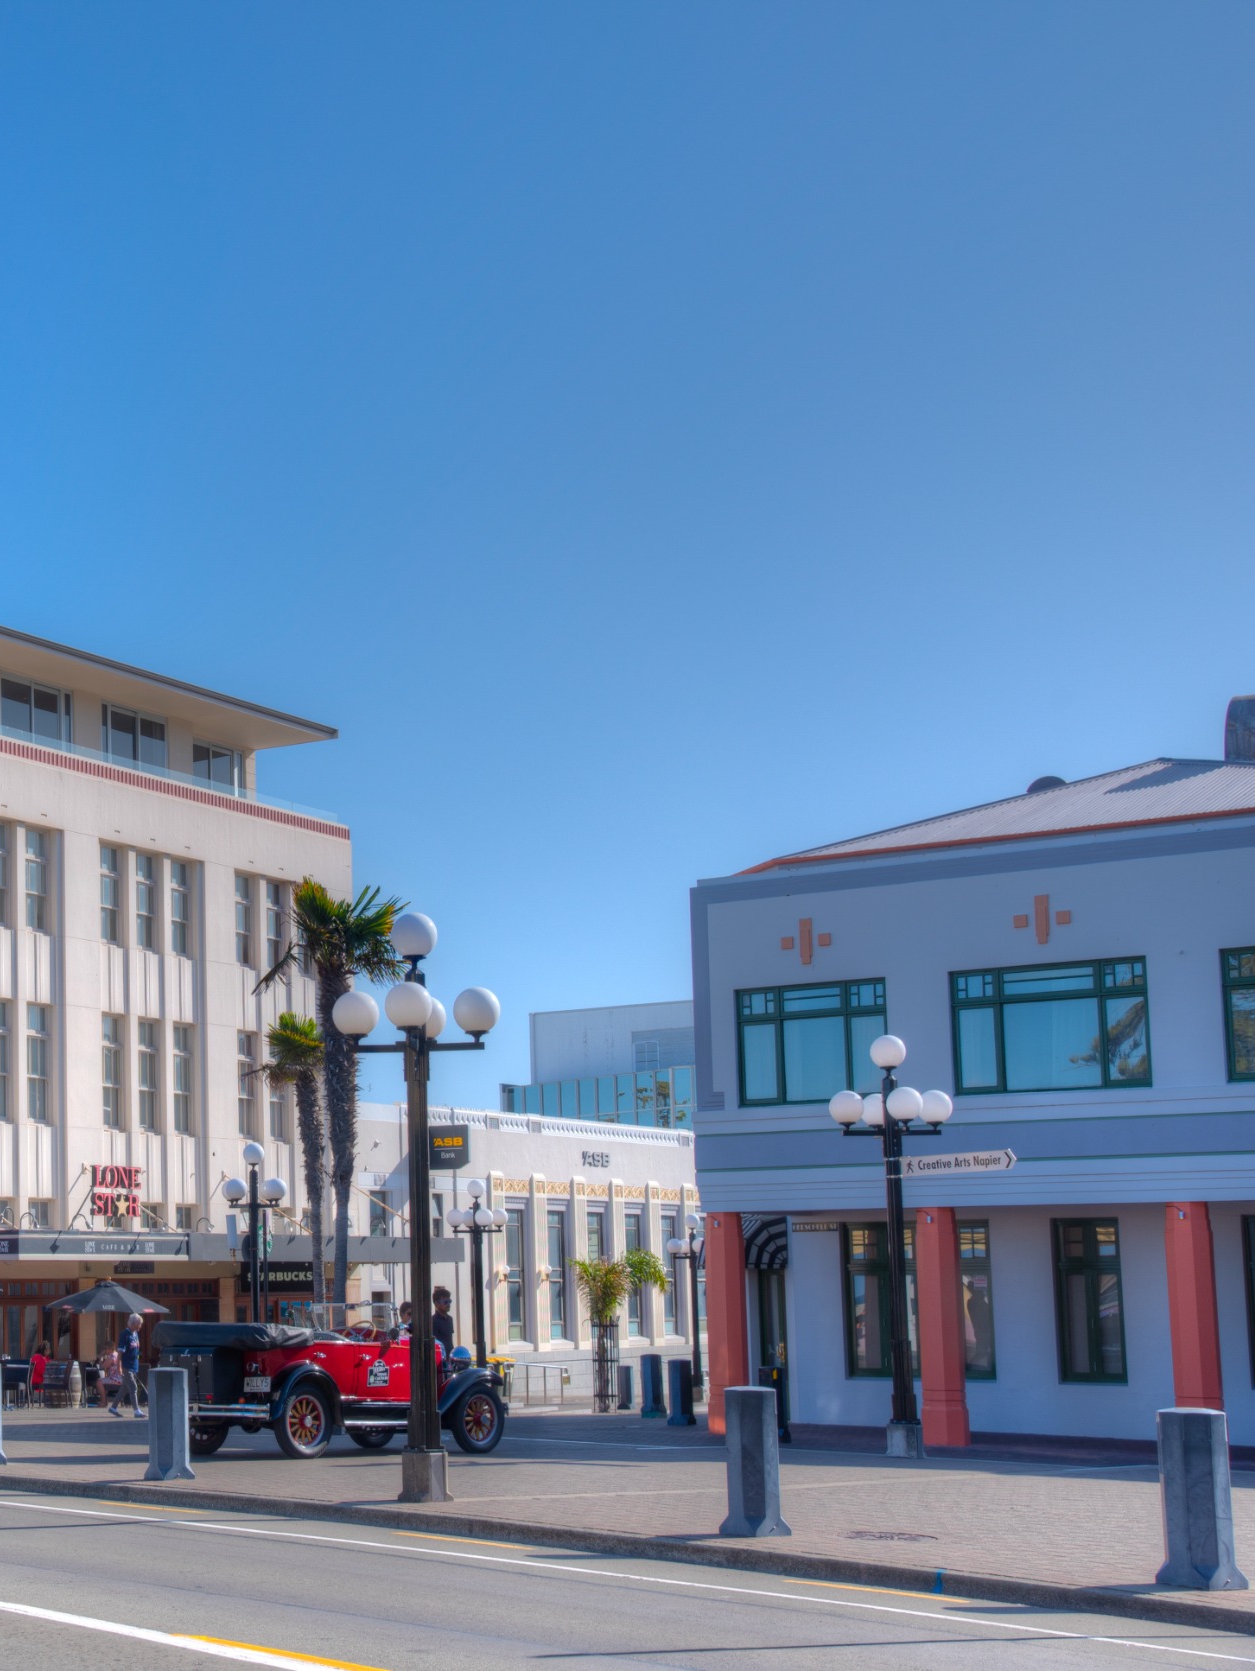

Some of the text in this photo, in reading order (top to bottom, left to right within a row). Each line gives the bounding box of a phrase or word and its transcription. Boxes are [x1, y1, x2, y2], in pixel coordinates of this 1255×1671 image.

[433, 1136, 463, 1147] ASB
[440, 1151, 456, 1159] Bank
[917, 1154, 1001, 1171] Creative Arts Napier
[90, 1164, 141, 1190] LONE
[247, 1271, 313, 1281] SARBUCKS
[245, 1377, 269, 1388] WILLYS
